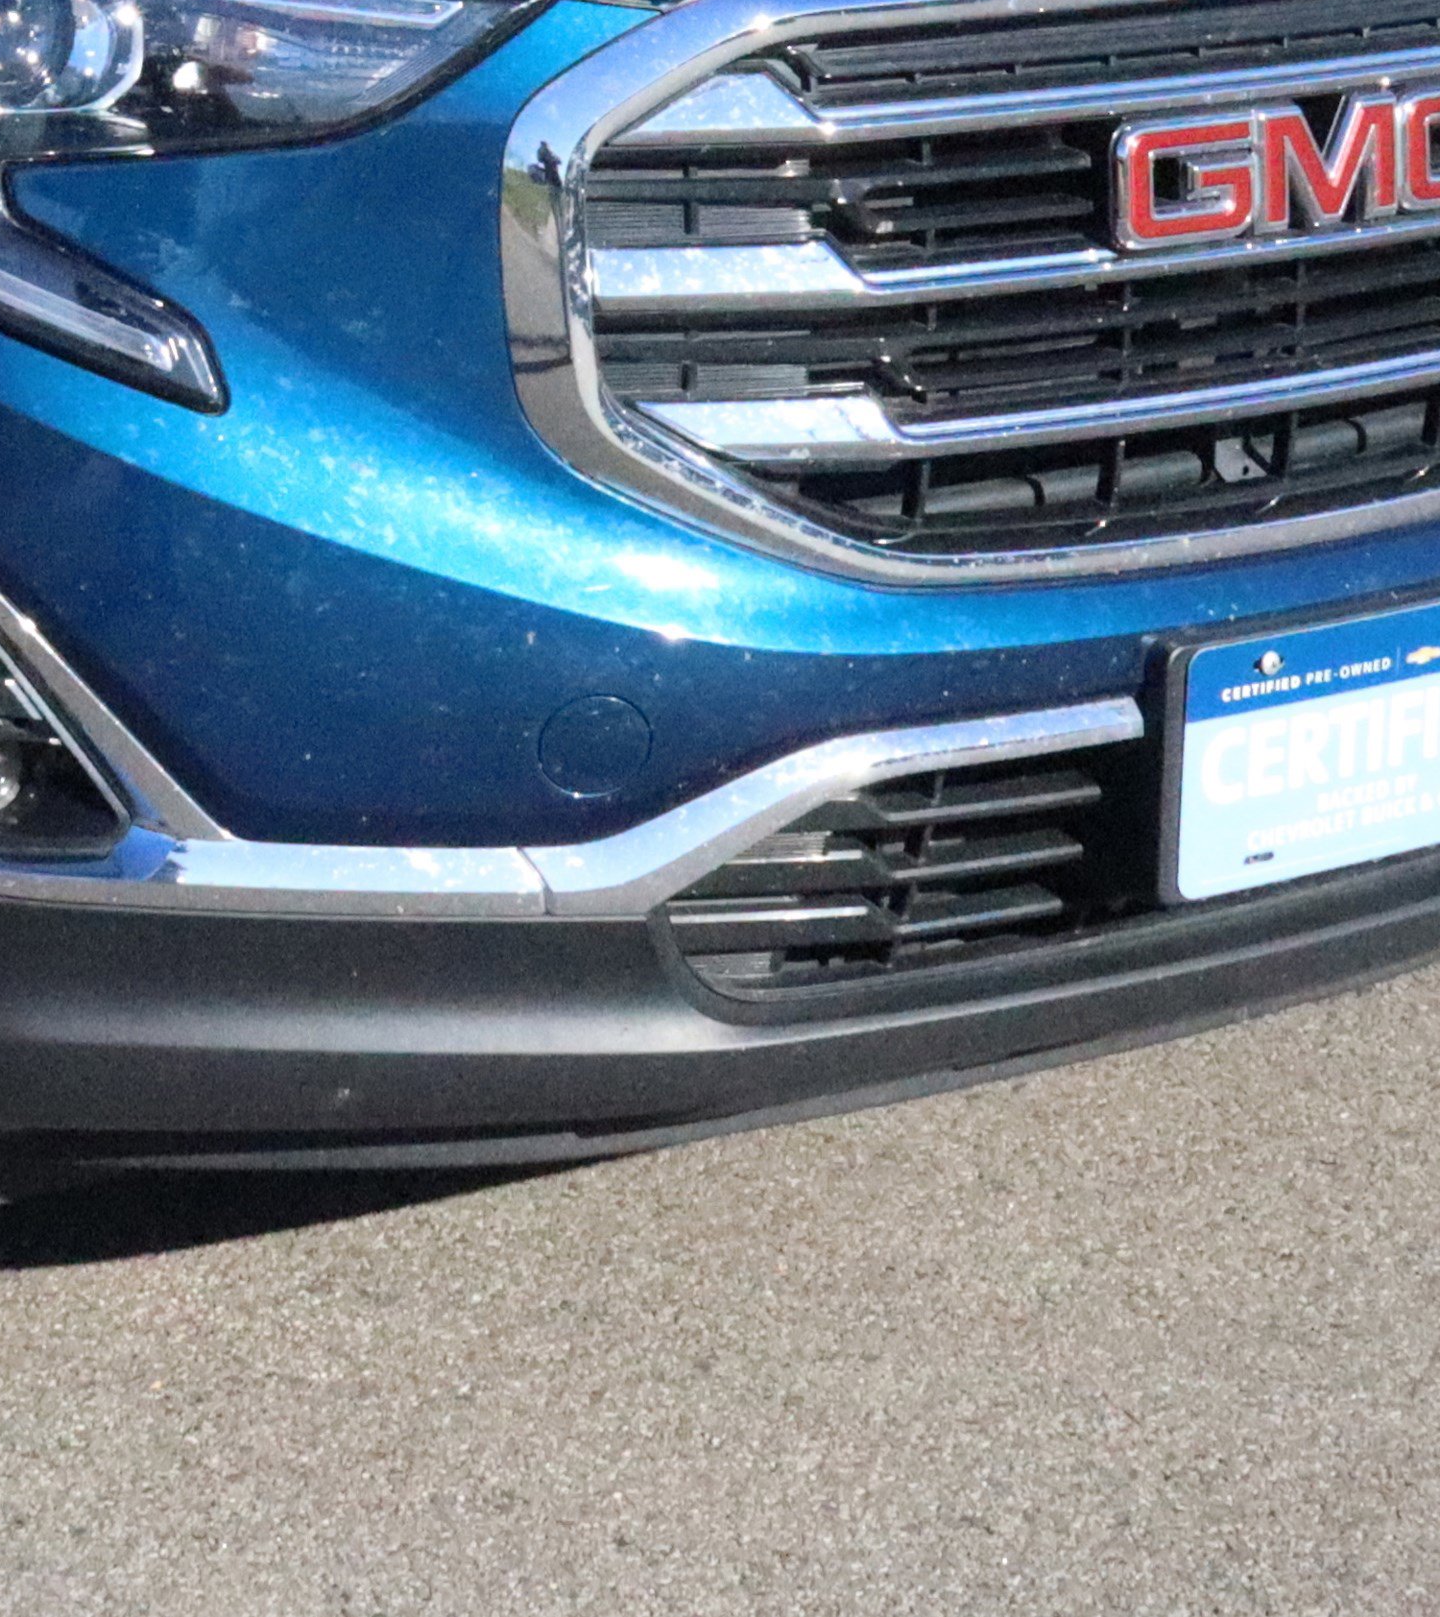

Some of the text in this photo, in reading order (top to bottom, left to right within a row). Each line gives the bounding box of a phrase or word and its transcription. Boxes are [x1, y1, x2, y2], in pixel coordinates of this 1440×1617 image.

[1221, 675, 1302, 703] CERTIFIED
[1317, 773, 1419, 812] BACKED BY
[1246, 809, 1356, 852] CHEVROLET
[1359, 795, 1418, 826] BUICK
